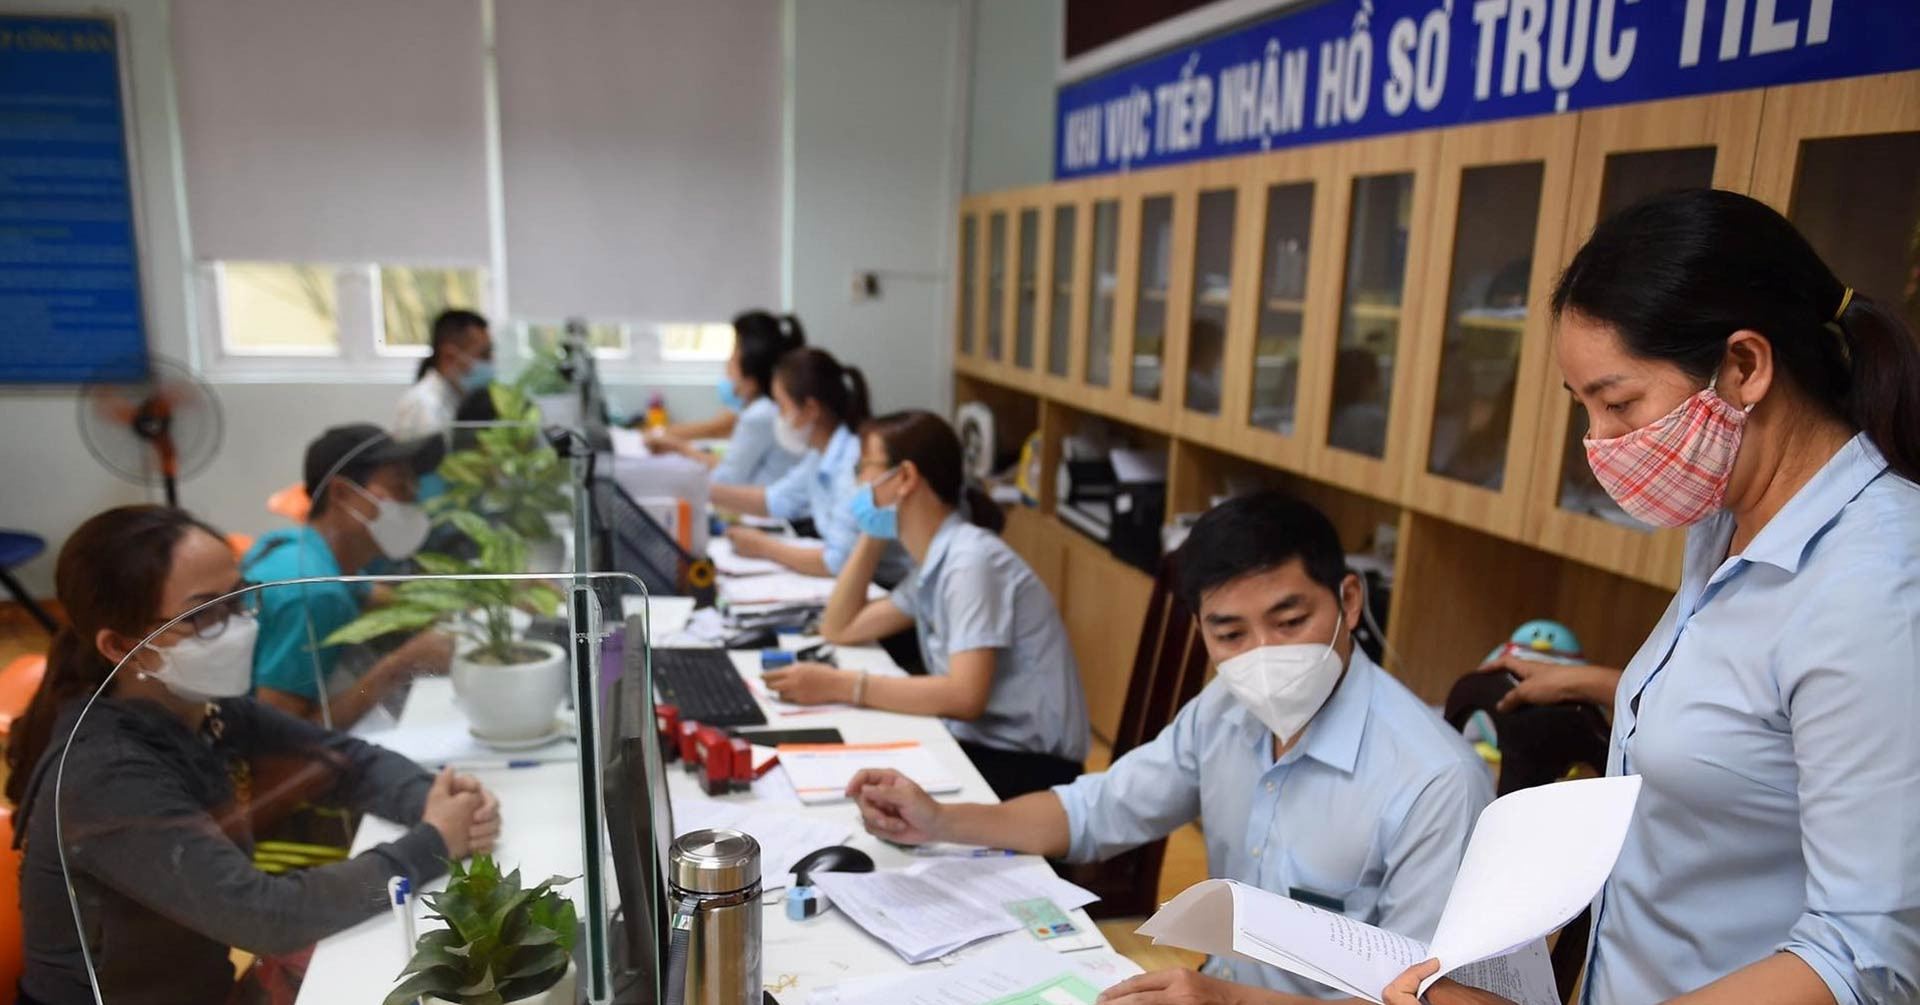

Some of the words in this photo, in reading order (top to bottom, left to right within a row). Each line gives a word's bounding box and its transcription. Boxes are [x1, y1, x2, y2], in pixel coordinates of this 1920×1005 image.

[1155, 57, 1214, 154] TIẾP
[1216, 38, 1308, 151] NHẬN
[1314, 0, 1374, 128] HỒ
[1383, 0, 1454, 116] SƠ
